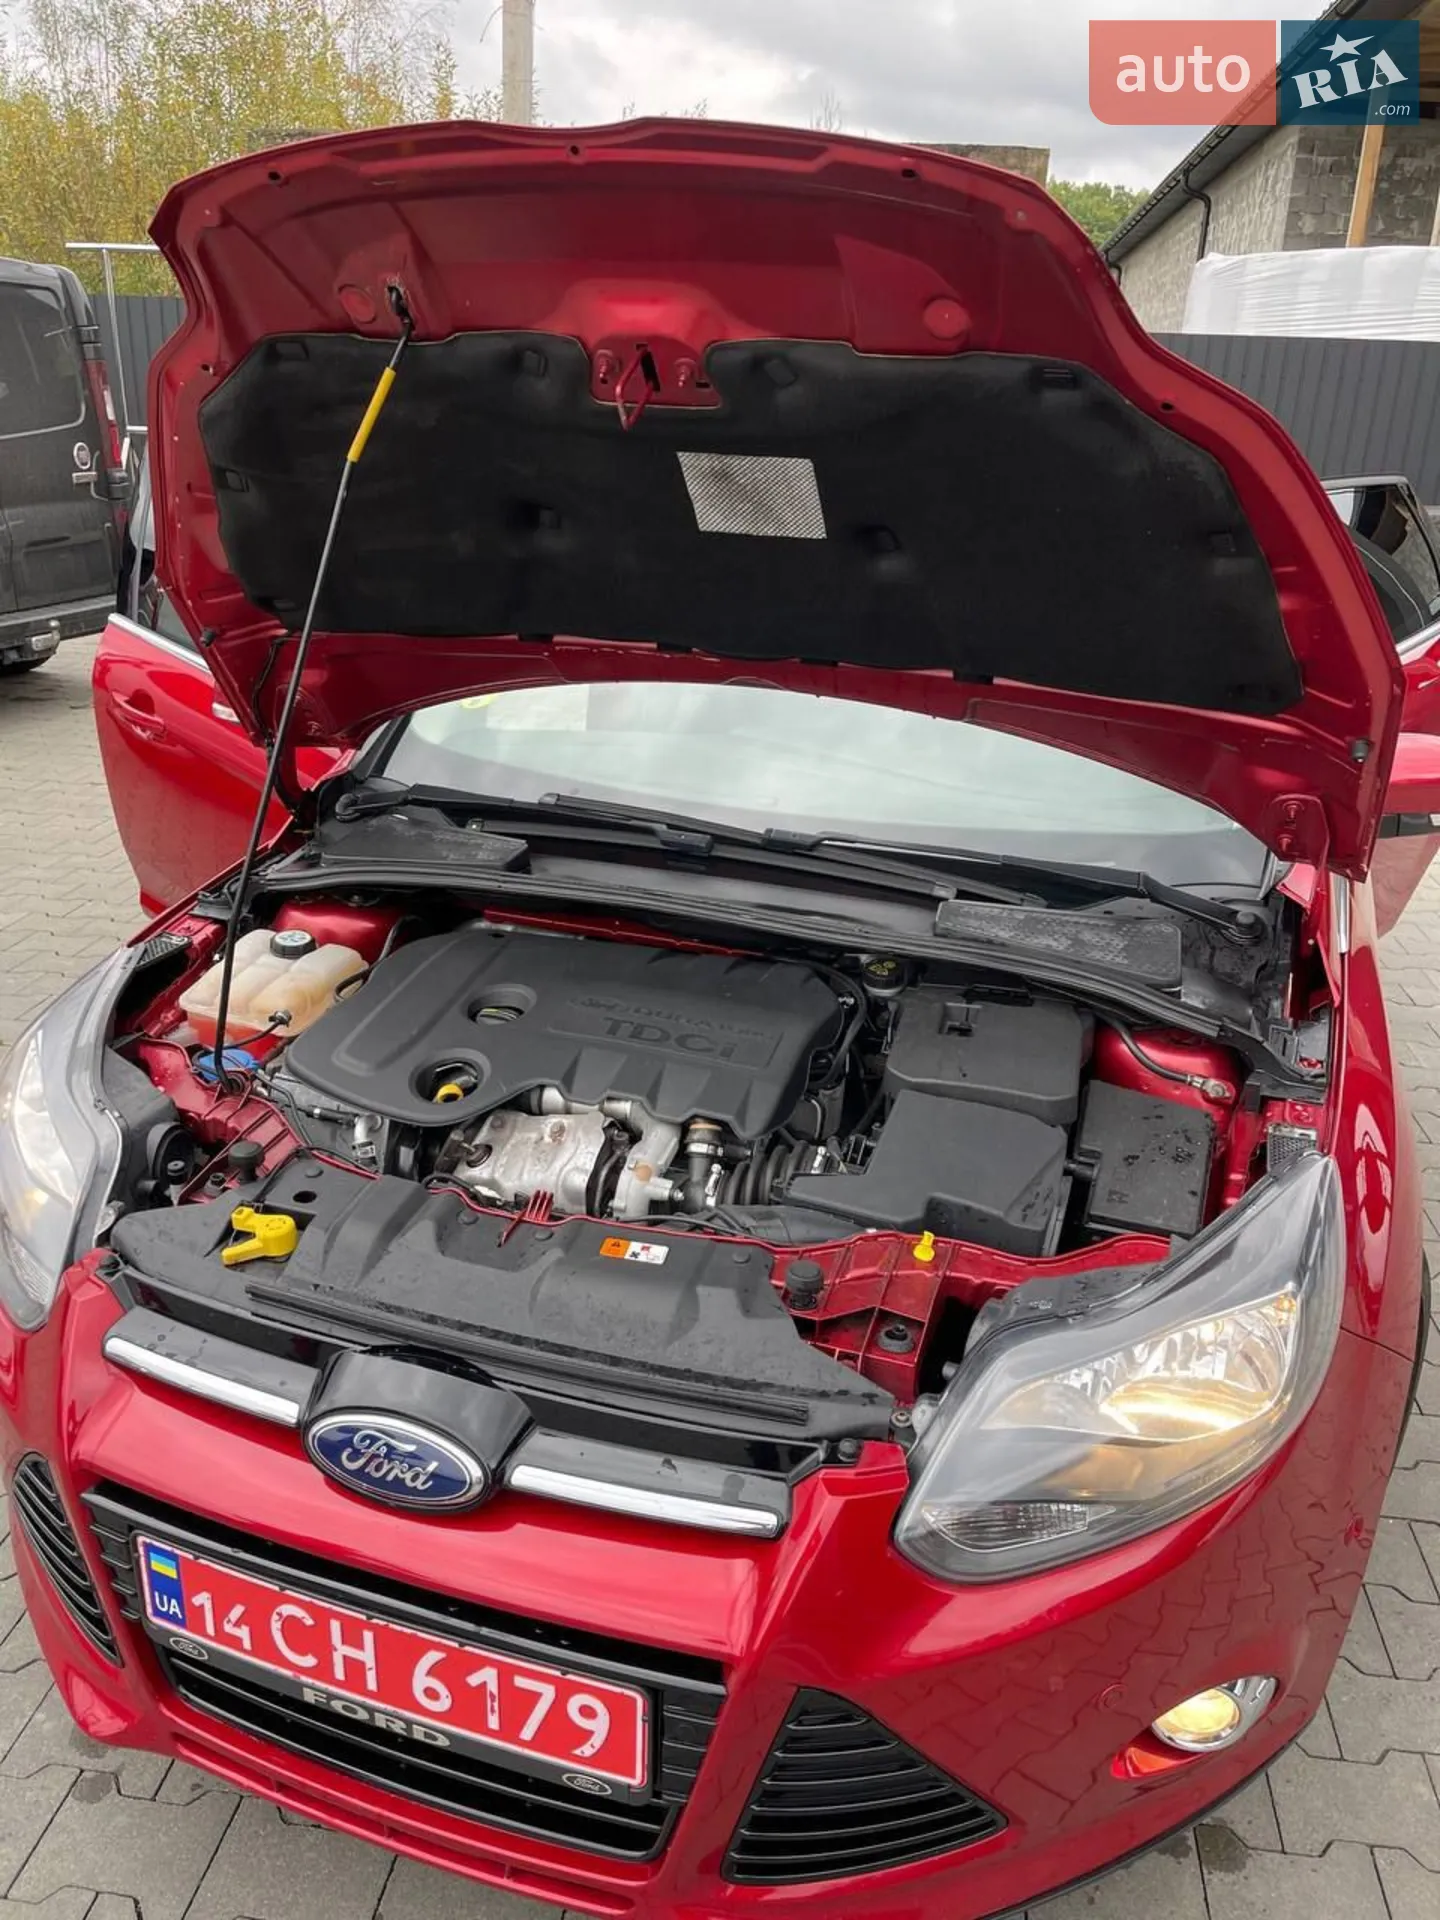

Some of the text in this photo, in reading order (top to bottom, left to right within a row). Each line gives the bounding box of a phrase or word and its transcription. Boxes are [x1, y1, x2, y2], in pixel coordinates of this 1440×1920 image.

[341, 1429, 440, 1491] Ford
[154, 1591, 183, 1620] UA
[191, 1591, 612, 1759] 14 CH 6179
[302, 1686, 451, 1748] FORD
